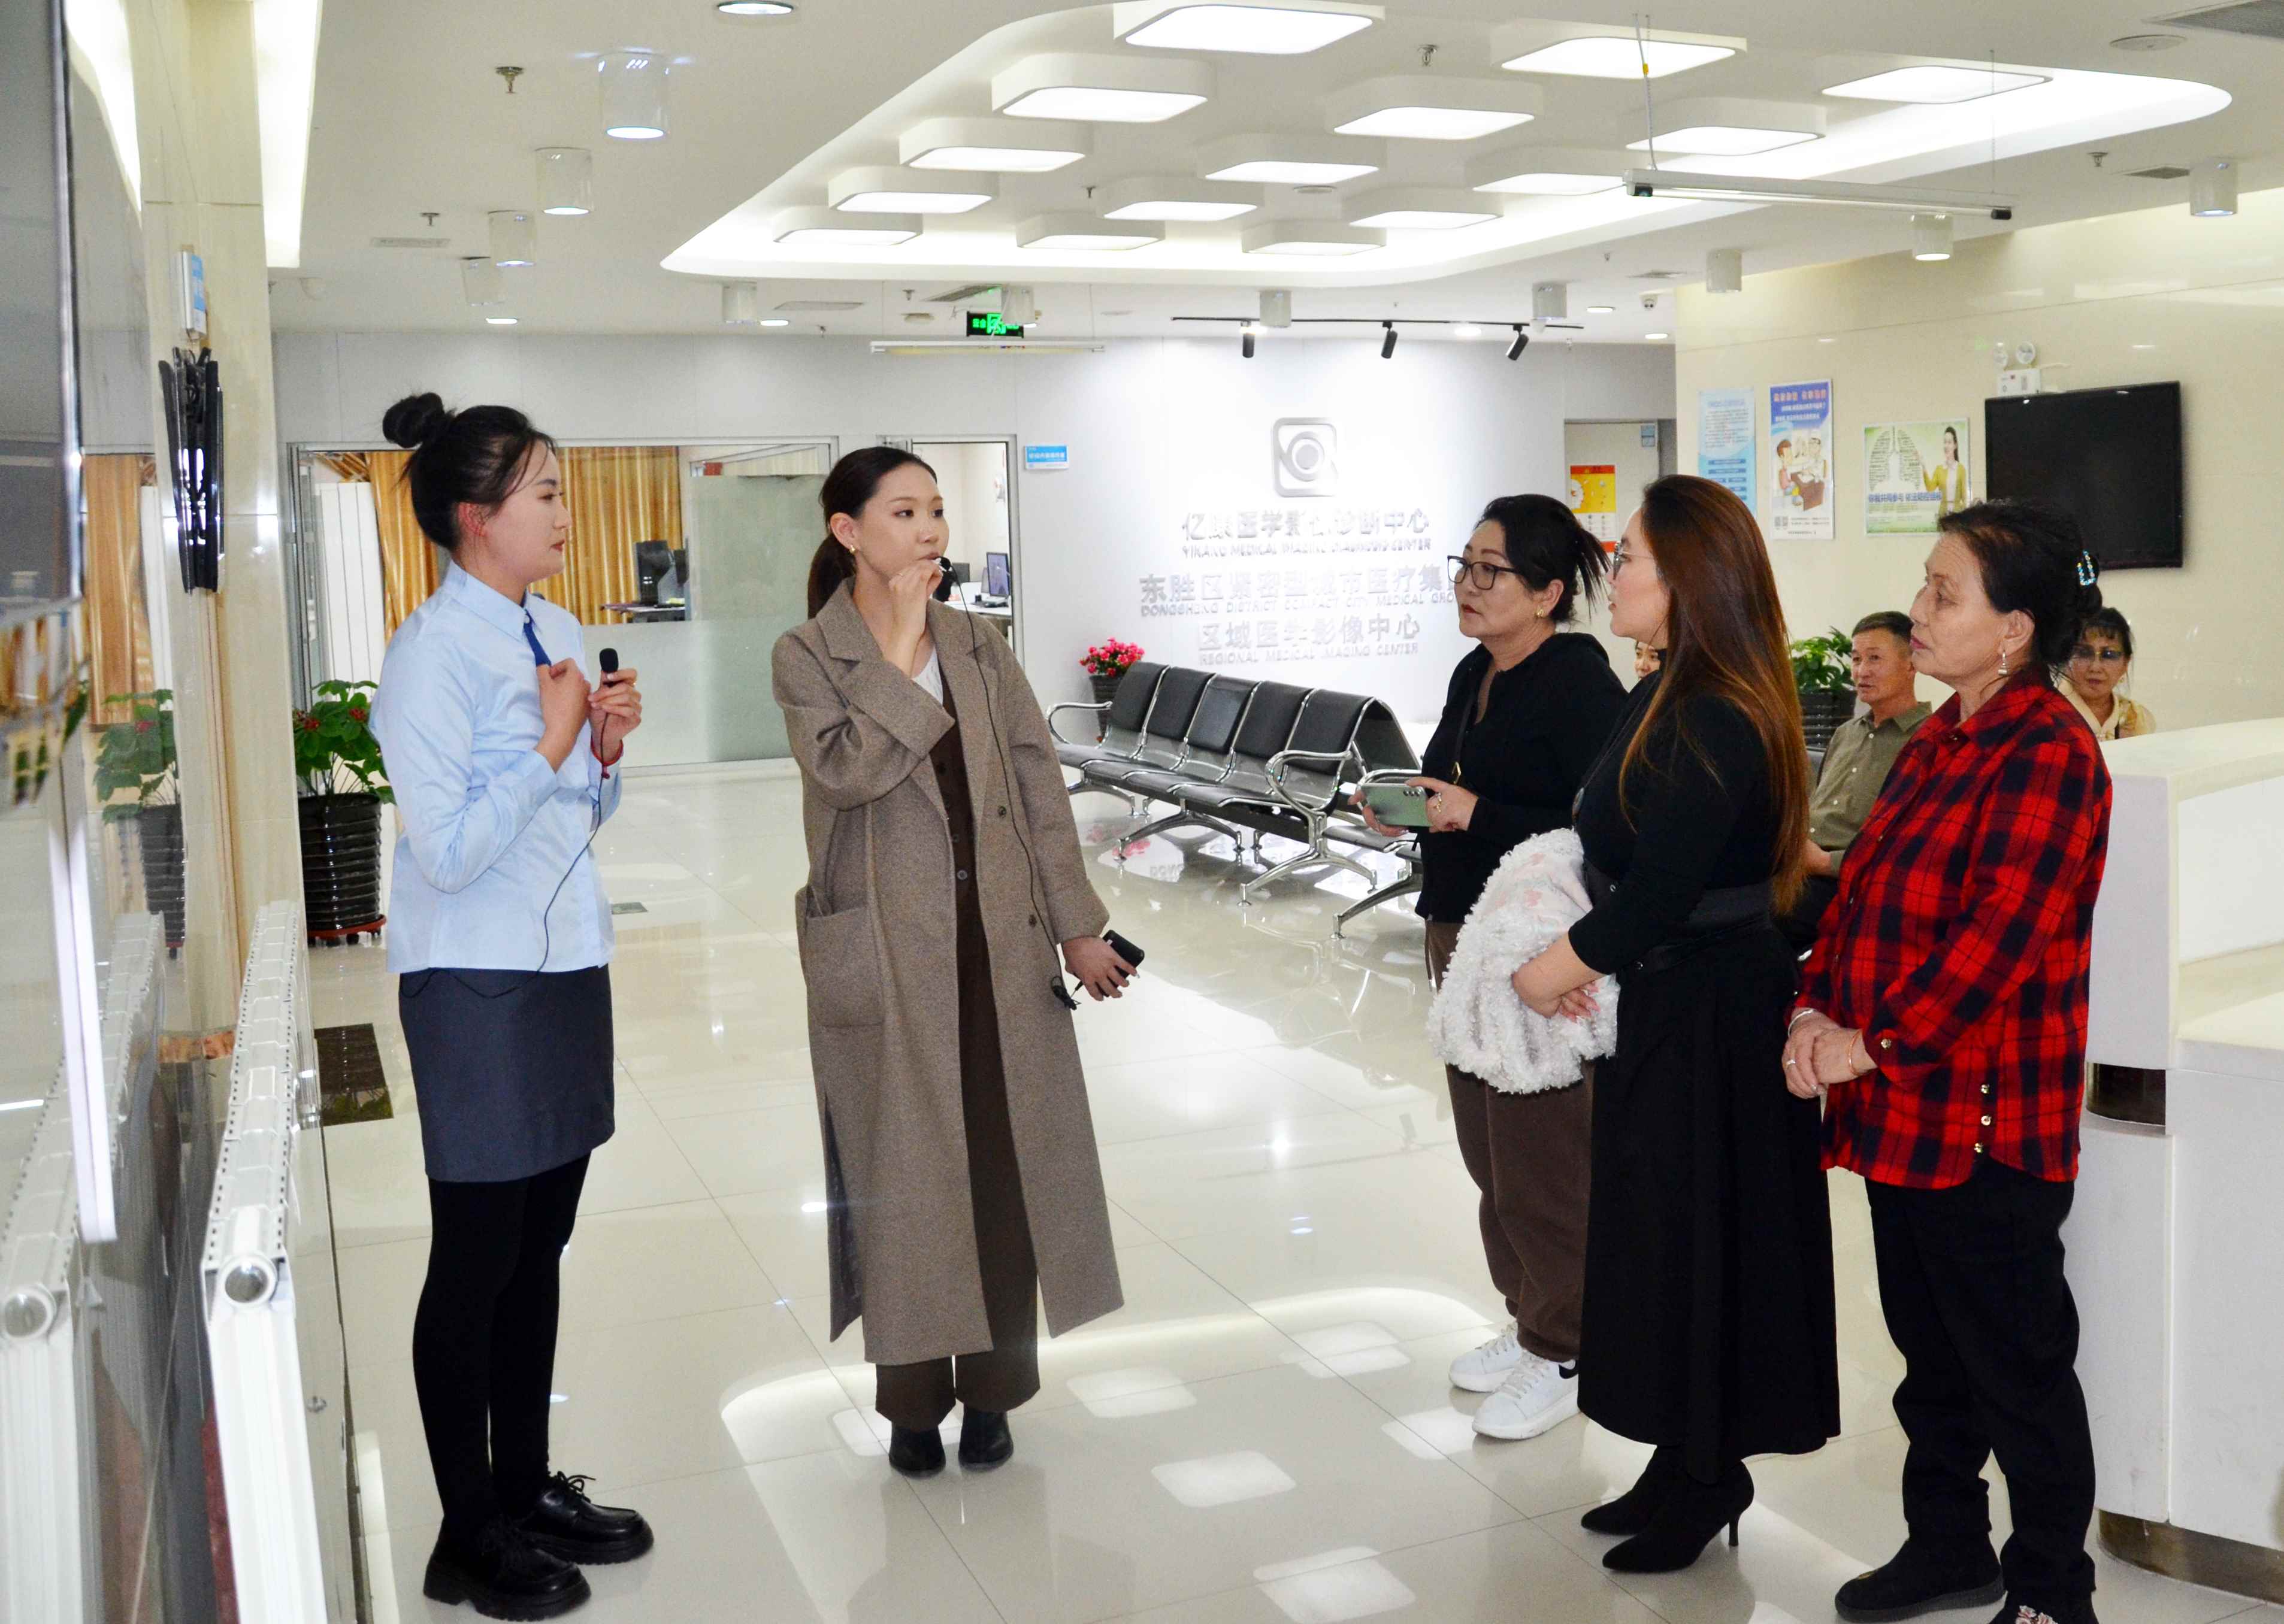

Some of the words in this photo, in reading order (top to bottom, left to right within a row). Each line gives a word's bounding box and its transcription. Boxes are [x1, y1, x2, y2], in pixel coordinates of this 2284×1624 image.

[1182, 508, 1430, 541] 亿医学影诊断中心
[1139, 564, 1456, 603] 东胜区紧密型城市医疗集
[1141, 602, 1218, 617] DONGSHENG
[1226, 599, 1276, 613] DISTRICT
[1377, 593, 1424, 605] MEDICAL
[1432, 592, 1454, 604] GRO
[1199, 613, 1420, 652] 区域医学影像中心
[1200, 651, 1258, 665] REGIONAL
[1266, 648, 1315, 661] MEDICAL
[1377, 643, 1418, 657] CENTER
